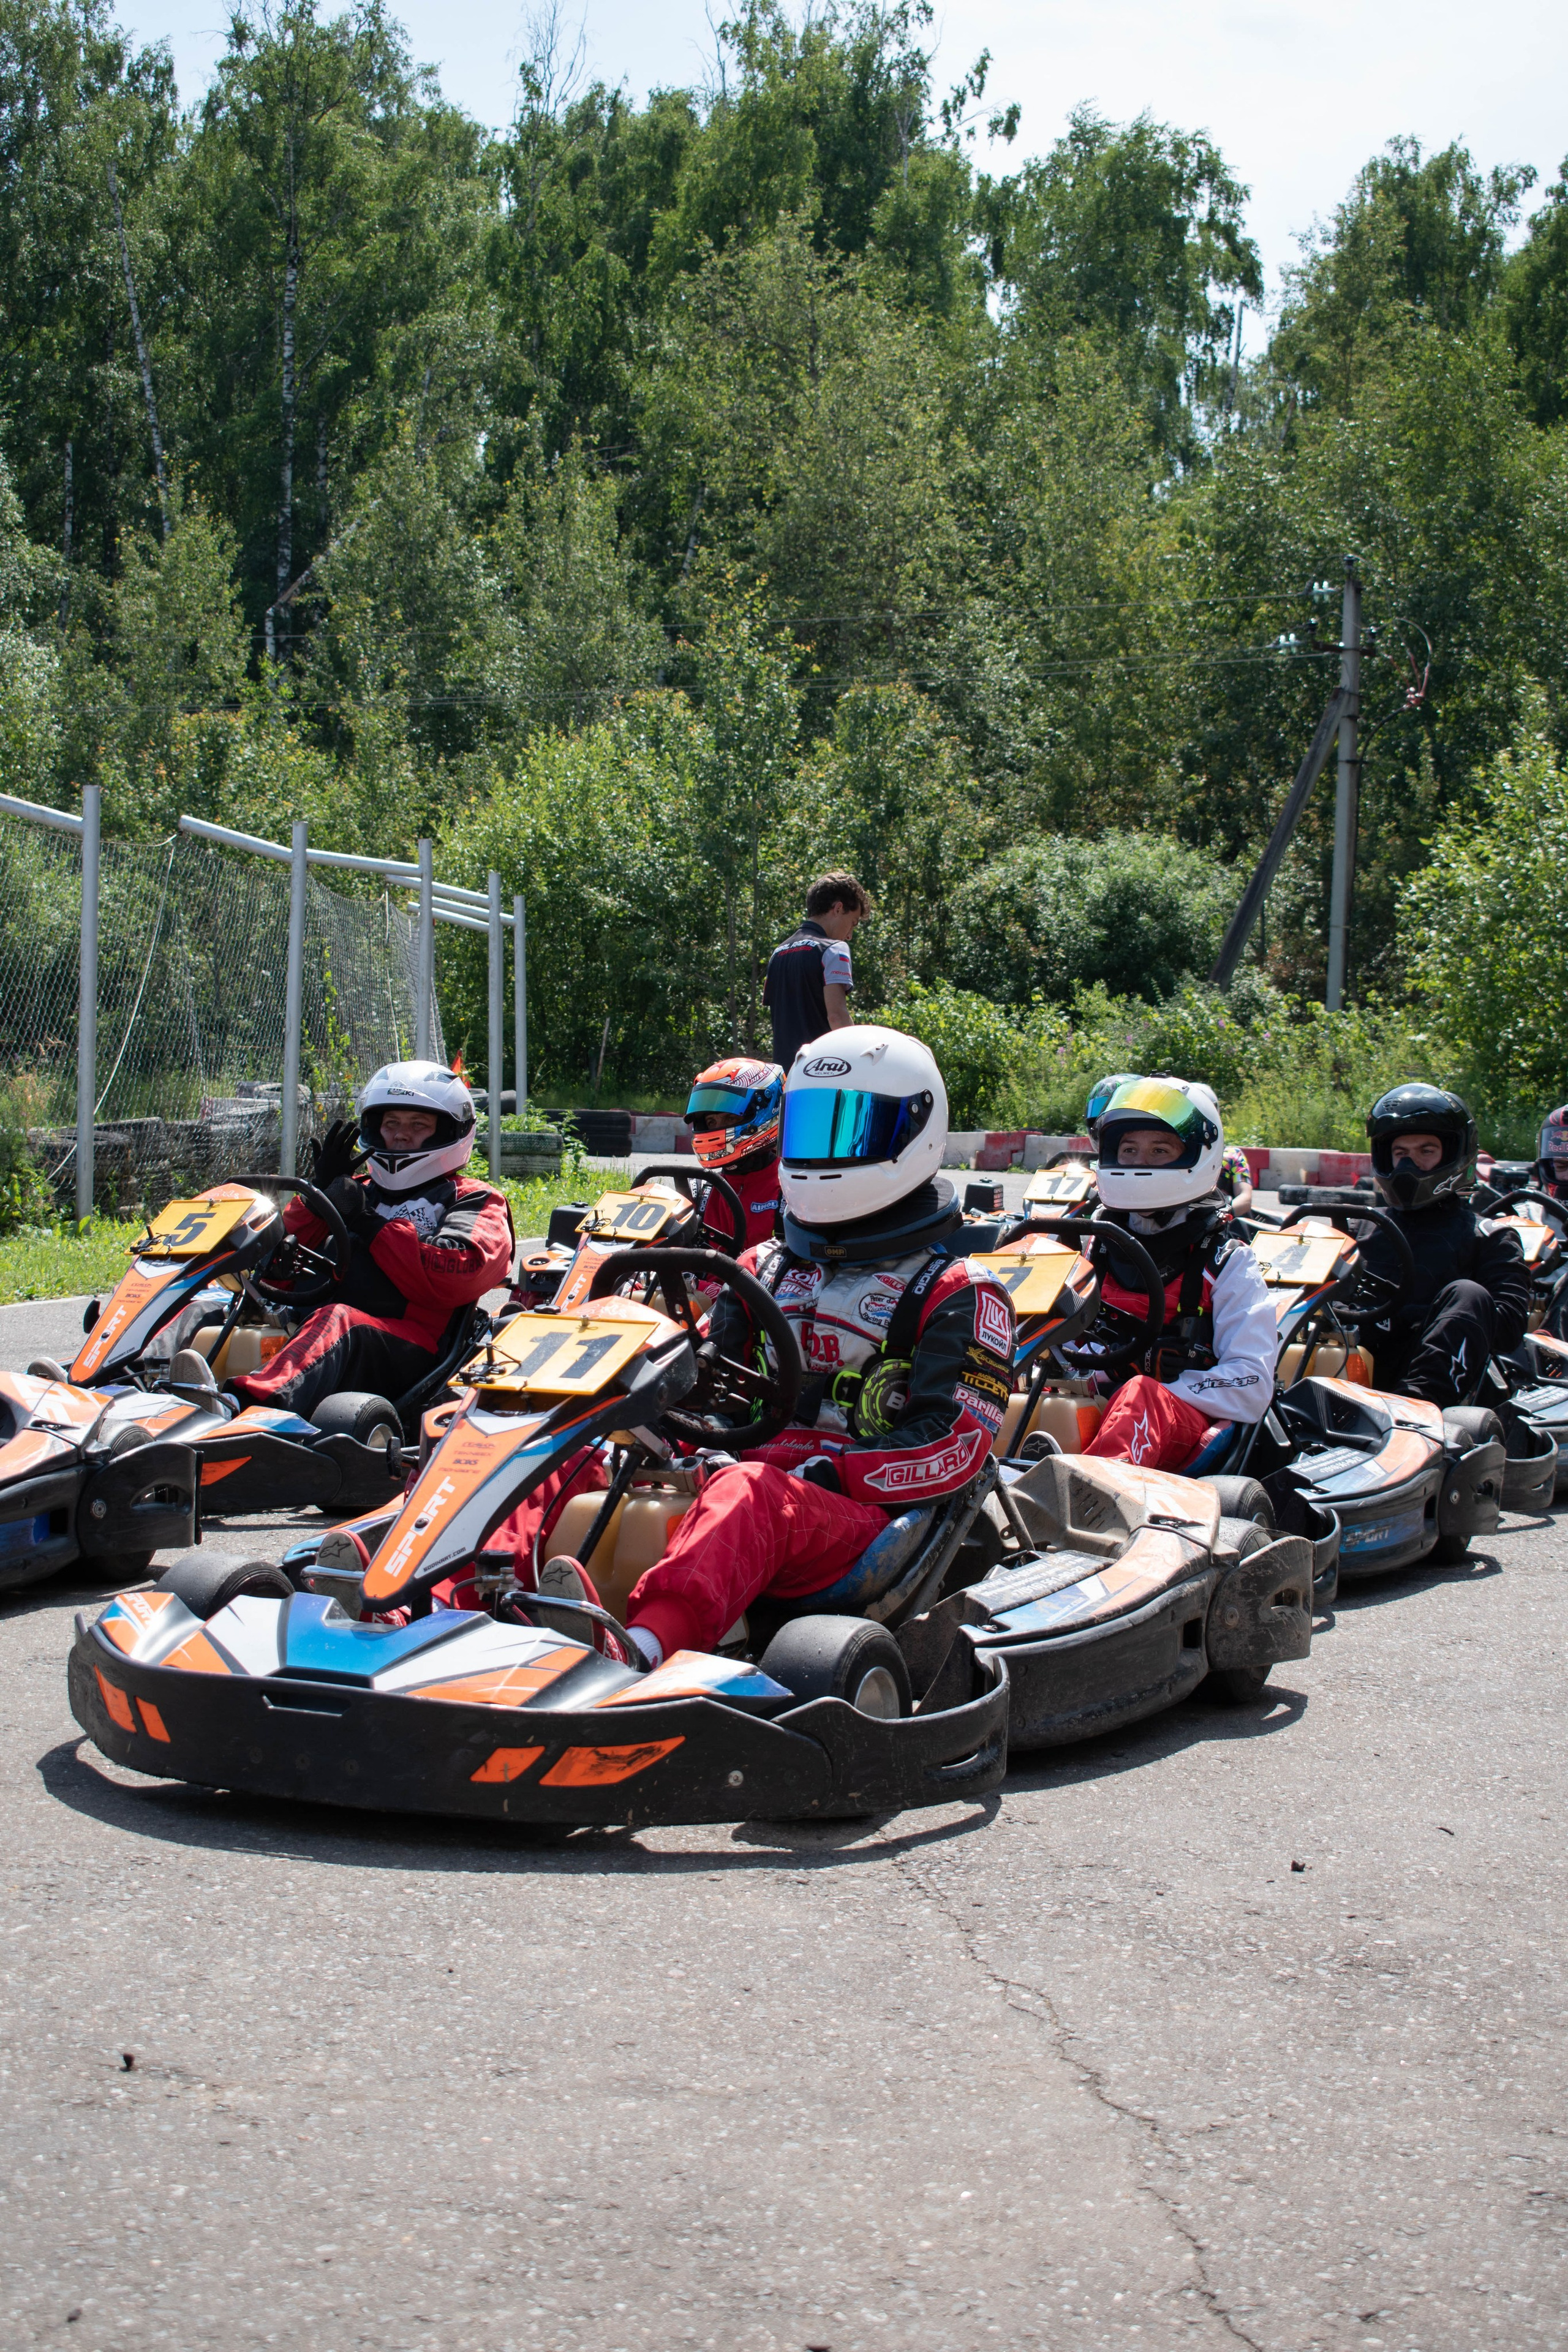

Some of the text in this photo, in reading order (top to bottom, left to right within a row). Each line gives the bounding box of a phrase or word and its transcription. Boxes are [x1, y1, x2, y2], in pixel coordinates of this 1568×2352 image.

[805, 1059, 846, 1072] Arai
[1047, 1176, 1084, 1195] 17
[162, 1212, 217, 1247] 5
[609, 1201, 666, 1231] 10
[914, 1259, 946, 1295] BENGIO
[1270, 1245, 1311, 1274] 4
[560, 1273, 587, 1313] PORT
[882, 1275, 907, 1291] GILLA
[998, 1266, 1034, 1294] 7
[83, 1305, 127, 1369] SPORT
[981, 1330, 1008, 1352] ЛУКОЙЛ
[508, 1331, 624, 1379] 11
[954, 1387, 1005, 1428] Parilla
[890, 1444, 968, 1484] GILLARD
[383, 1475, 456, 1578] SPORT
